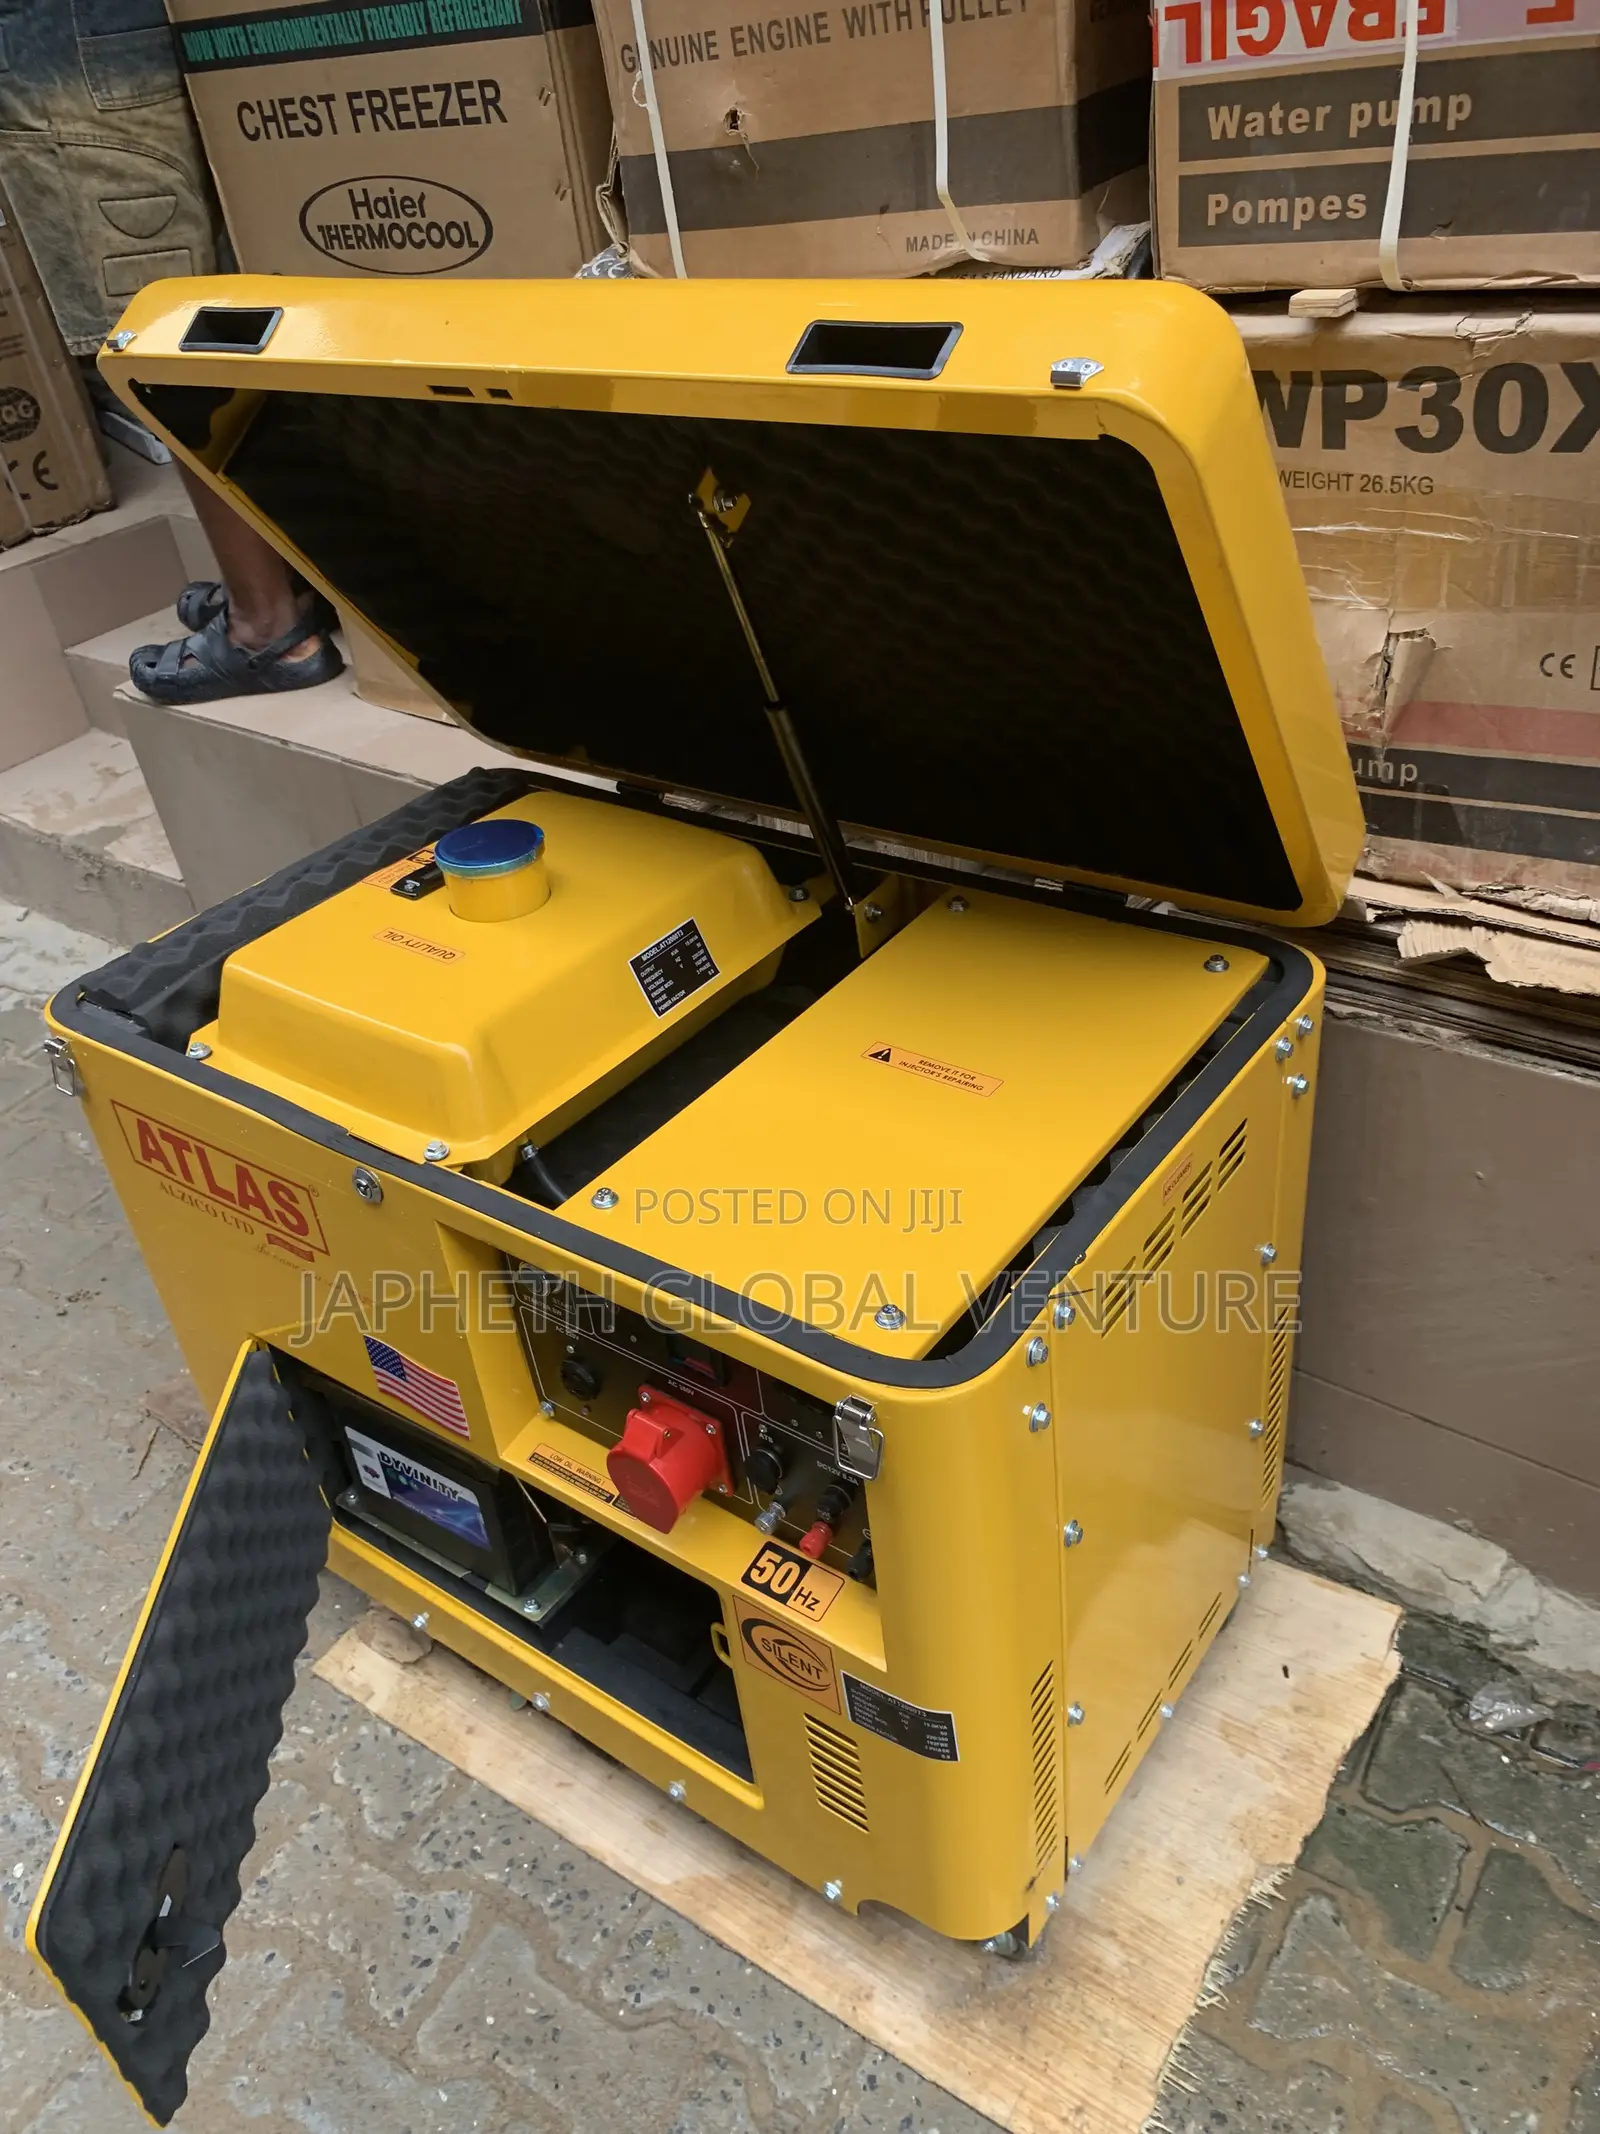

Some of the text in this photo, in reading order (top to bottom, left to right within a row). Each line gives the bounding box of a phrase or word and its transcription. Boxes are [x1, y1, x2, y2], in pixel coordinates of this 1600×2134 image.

[182, 0, 523, 61] NOW WITH ENVIRONMENTALLY FRIENDLY REFRIGERANT
[621, 30, 719, 73] GNUINE
[730, 11, 831, 57] ENGINE
[842, 0, 913, 39] WITH
[1150, 0, 1446, 68] FRAGIL
[237, 79, 508, 142] CHEST FREEZER
[1207, 92, 1473, 140] Water pump
[347, 187, 427, 220] Haier
[1207, 193, 1368, 231] Pompes
[317, 220, 480, 251] THERMOCOOL
[906, 233, 955, 253] MADE
[981, 228, 1040, 246] CHINA
[1278, 470, 1435, 496] WEIGHT 26.5KG
[1353, 760, 1418, 786] ump
[383, 931, 456, 960] QUALITY OIL
[898, 1061, 984, 1091] INJECTOR'S REPAIRING
[918, 1059, 977, 1081] REMOVE IT FOR
[136, 1118, 309, 1237] ATLAS
[220, 1211, 256, 1236] LTD
[758, 1432, 774, 1444] ATS
[378, 1450, 460, 1502] DYVINITY
[549, 1453, 563, 1464] LOW
[563, 1460, 573, 1470] OIL
[750, 1549, 821, 1612] 50 Hz
[761, 1637, 824, 1681] SILENT
